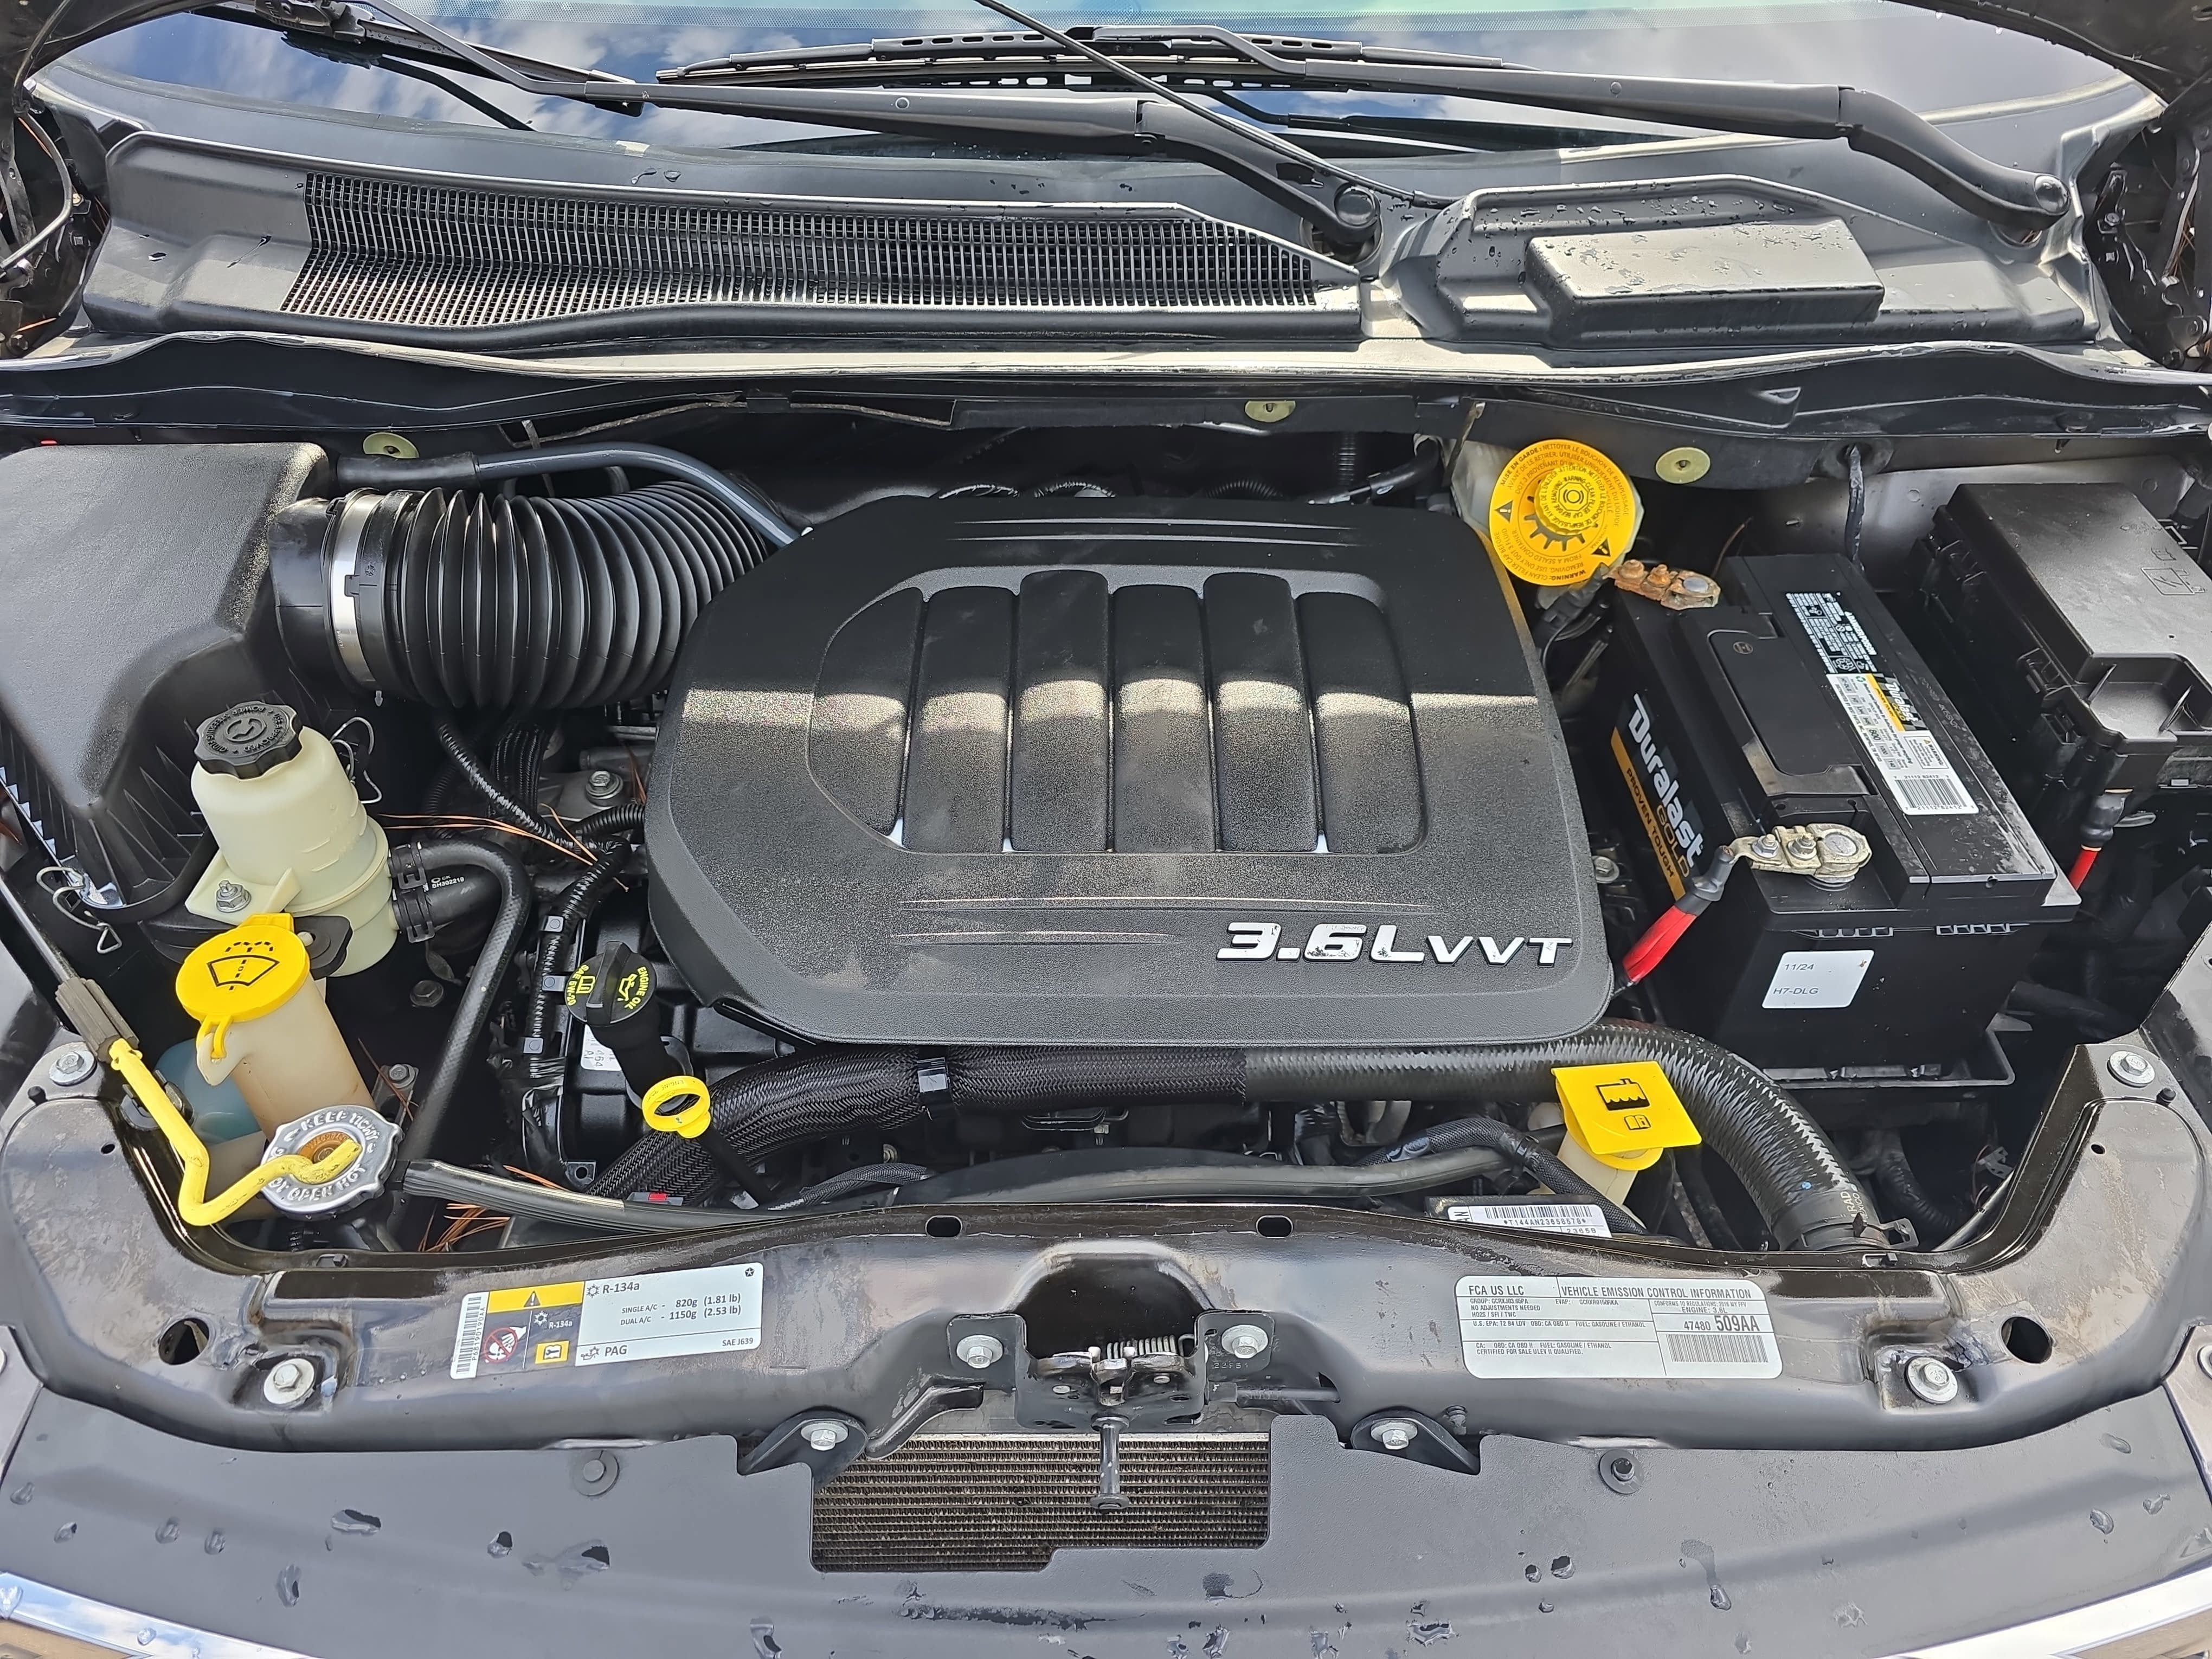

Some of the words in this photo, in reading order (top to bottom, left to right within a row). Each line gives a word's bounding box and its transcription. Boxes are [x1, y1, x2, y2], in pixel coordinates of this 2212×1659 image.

[1501, 470, 1512, 485] MISE
[1519, 448, 1538, 462] GARDE
[1885, 682, 1918, 723] Duralast
[1629, 693, 1703, 868] Duralast
[1627, 769, 1651, 824] PROVEN
[1652, 828, 1674, 877] TOUGH
[1657, 805, 1689, 877] GOLD
[1217, 922, 1425, 965] 3.6L
[1426, 935, 1573, 967] VVT
[572, 964, 589, 980] SAE
[637, 966, 649, 996] ENGINE
[567, 981, 577, 1006] 5W-20
[624, 996, 641, 1009] OIL
[300, 1110, 348, 1131] KEEP
[1840, 1191, 1857, 1212] RAD
[602, 1282, 640, 1294] R-134a
[1469, 1285, 1488, 1295] FCA
[1490, 1285, 1503, 1295] US
[1507, 1285, 1524, 1295] LLC
[1561, 1287, 1599, 1296] VEHICLE
[1601, 1287, 1644, 1297] EMISSION
[1647, 1288, 1688, 1297] CONTROL
[1690, 1288, 1752, 1298] INFORMATION
[621, 1306, 644, 1314] SINGLE
[645, 1304, 658, 1312] A/C
[676, 1298, 698, 1308] 820g
[704, 1295, 726, 1306] (1.81
[729, 1293, 741, 1303] lb)
[549, 1320, 573, 1329] R-134a
[620, 1317, 638, 1325] DUAL
[638, 1315, 651, 1324] A/C
[669, 1310, 697, 1320] 1150g
[704, 1307, 726, 1319] (2.53
[729, 1304, 741, 1315] lb)
[1684, 1321, 1711, 1330] 47480
[1714, 1315, 1760, 1332] 509AA
[605, 1345, 627, 1356] PAG
[722, 1339, 736, 1347] SAE
[738, 1338, 754, 1346] J639
